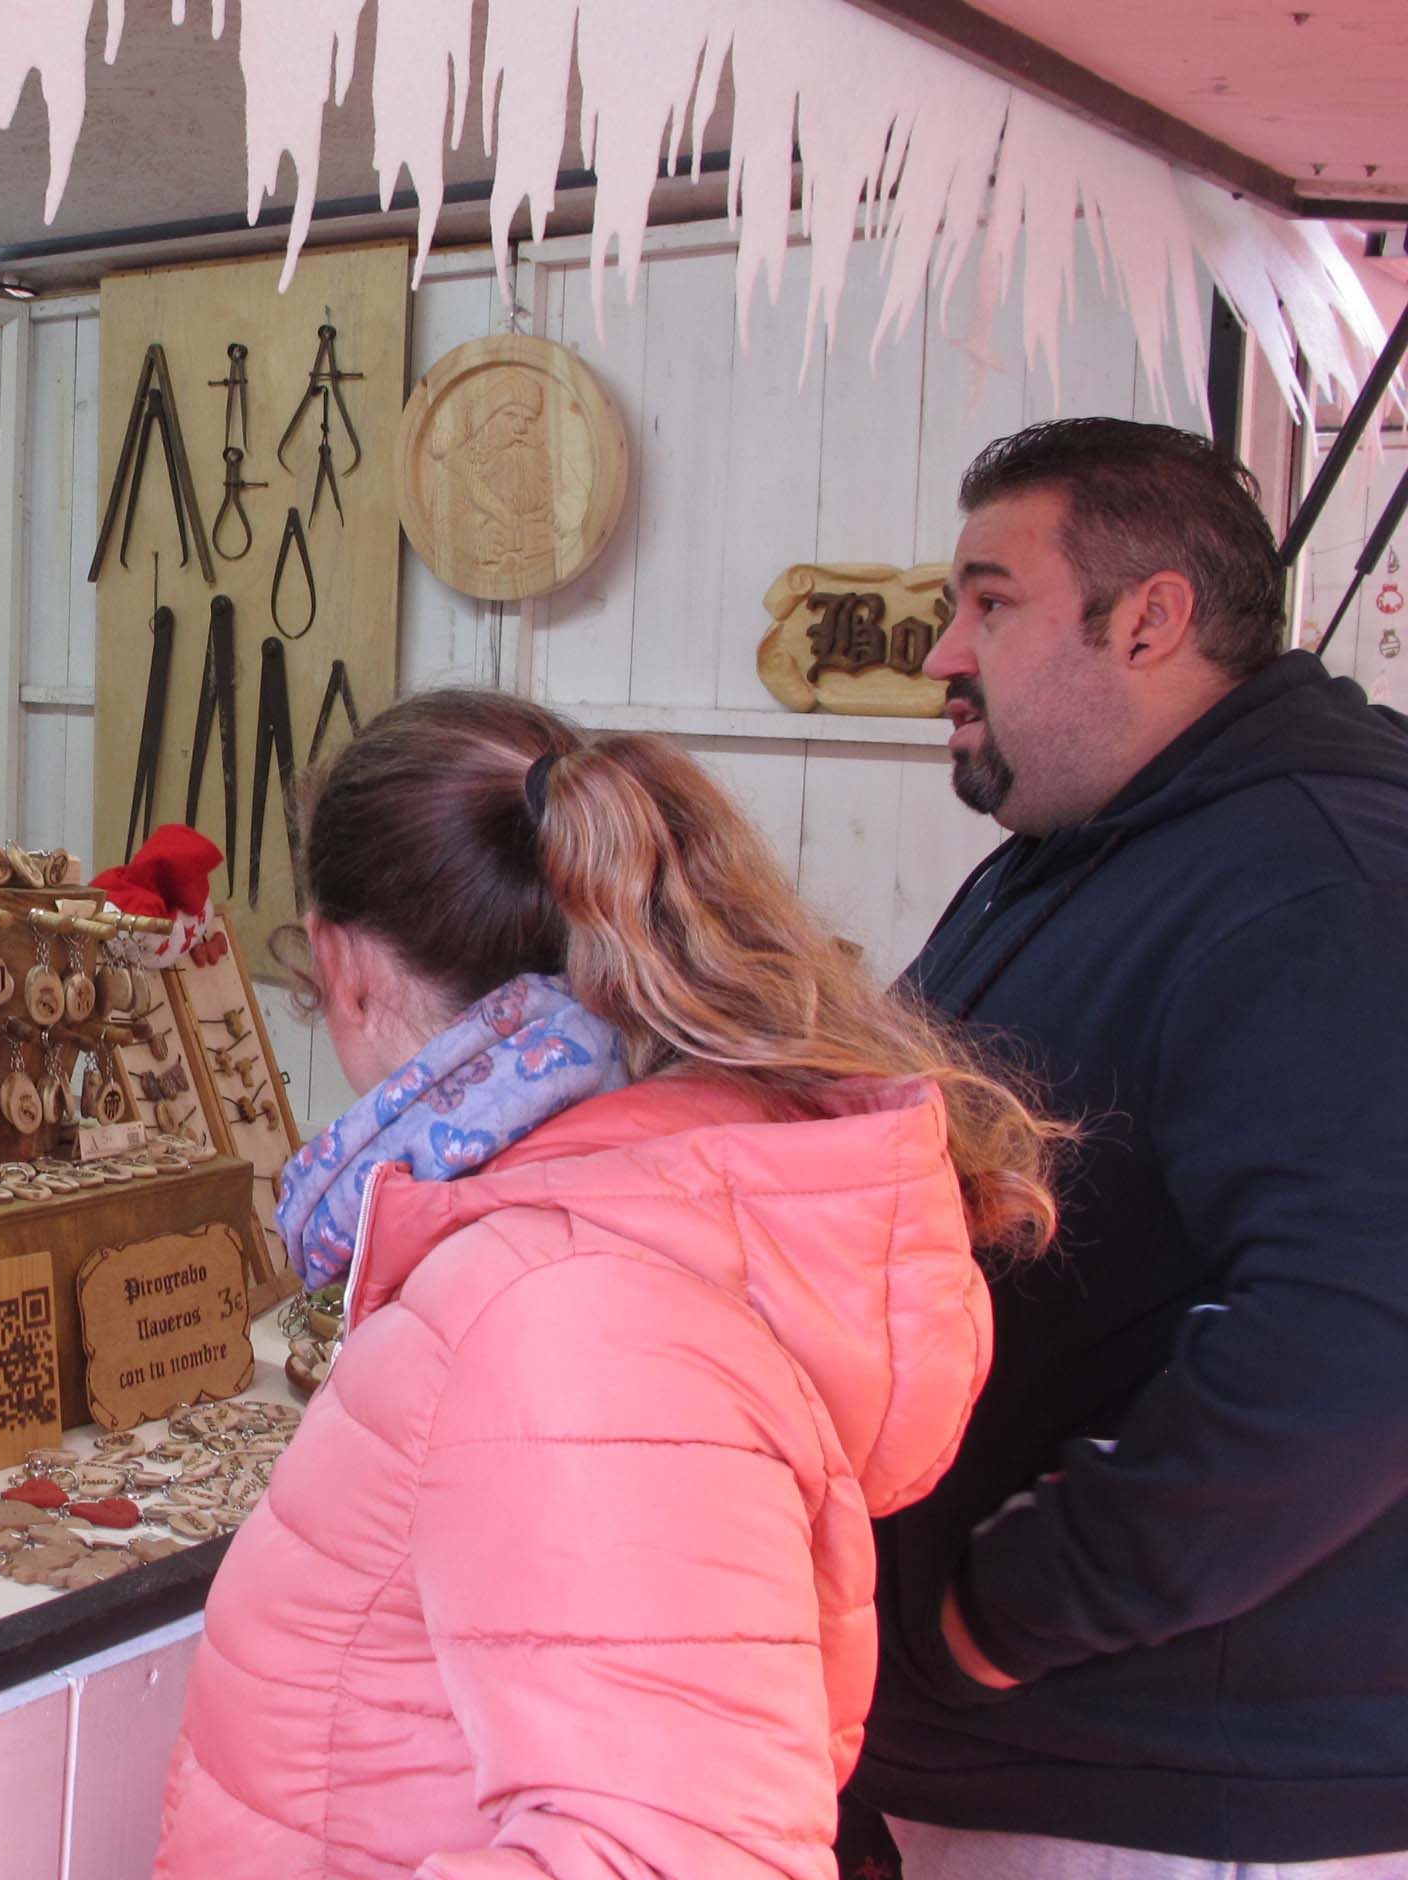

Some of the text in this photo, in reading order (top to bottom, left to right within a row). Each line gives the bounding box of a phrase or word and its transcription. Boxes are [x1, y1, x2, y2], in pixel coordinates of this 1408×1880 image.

[806, 584, 954, 684] Bo
[124, 1264, 208, 1305] Pirograbo
[137, 1305, 202, 1341] llaveros
[119, 1343, 228, 1390] con tu nombre
